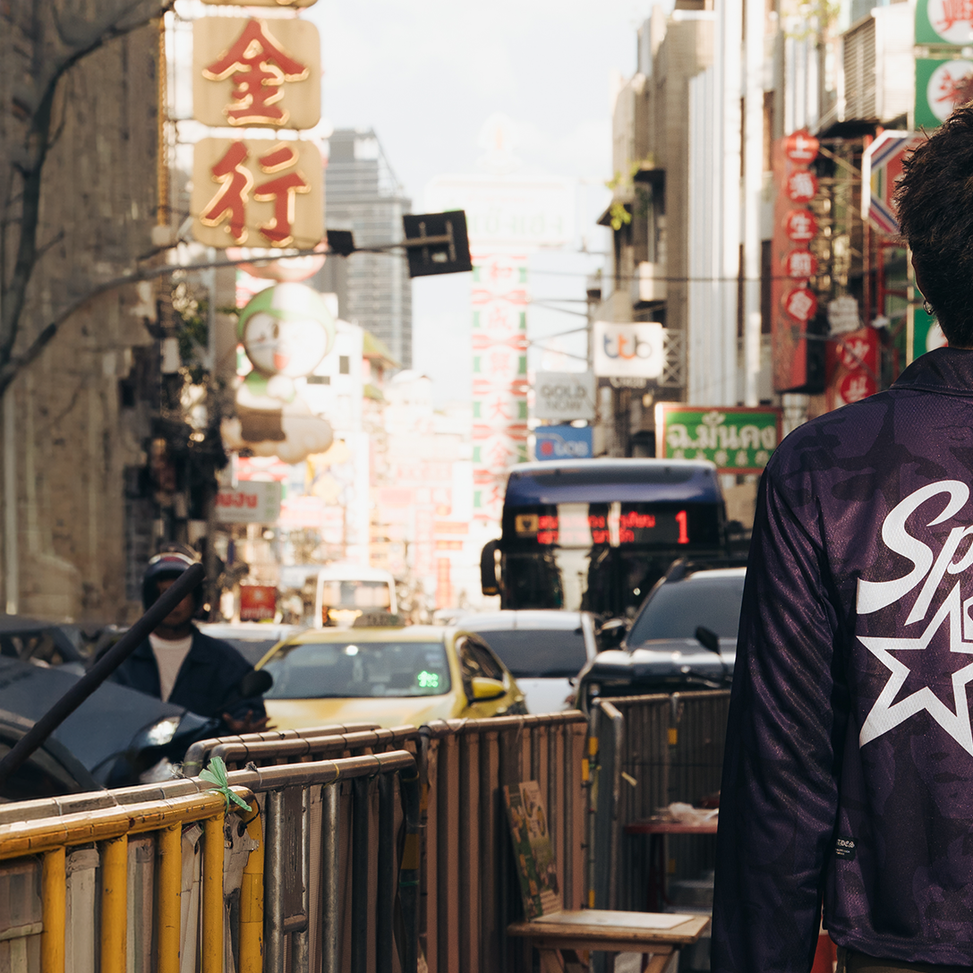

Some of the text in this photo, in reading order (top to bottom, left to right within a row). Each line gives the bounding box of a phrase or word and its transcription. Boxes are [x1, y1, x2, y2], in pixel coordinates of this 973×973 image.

[200, 18, 311, 247] 金行
[602, 333, 652, 360] ttb
[541, 384, 587, 398] GOLD
[675, 510, 689, 544] 1
